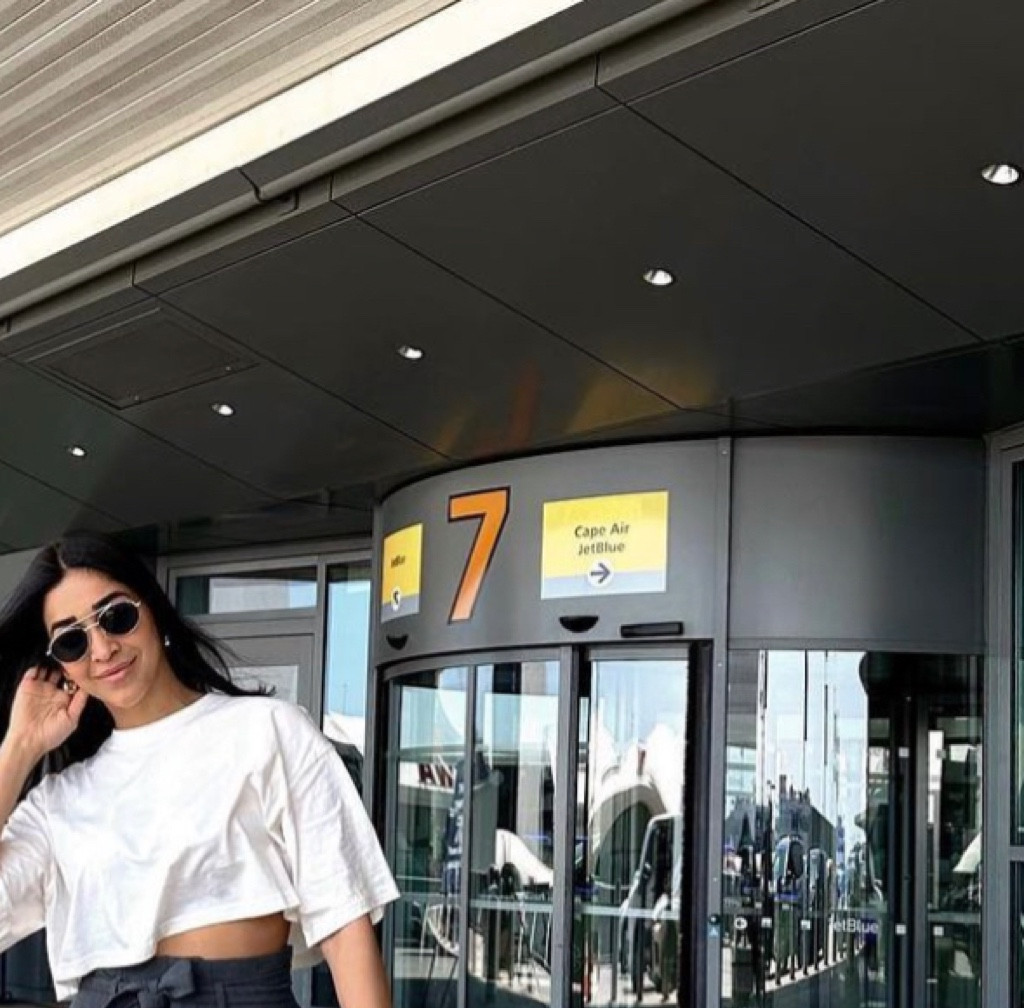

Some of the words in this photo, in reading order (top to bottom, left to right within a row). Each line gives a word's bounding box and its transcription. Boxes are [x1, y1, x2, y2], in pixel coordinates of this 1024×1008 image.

[448, 486, 511, 625] 7
[574, 524, 606, 540] Cape
[610, 521, 631, 535] Air
